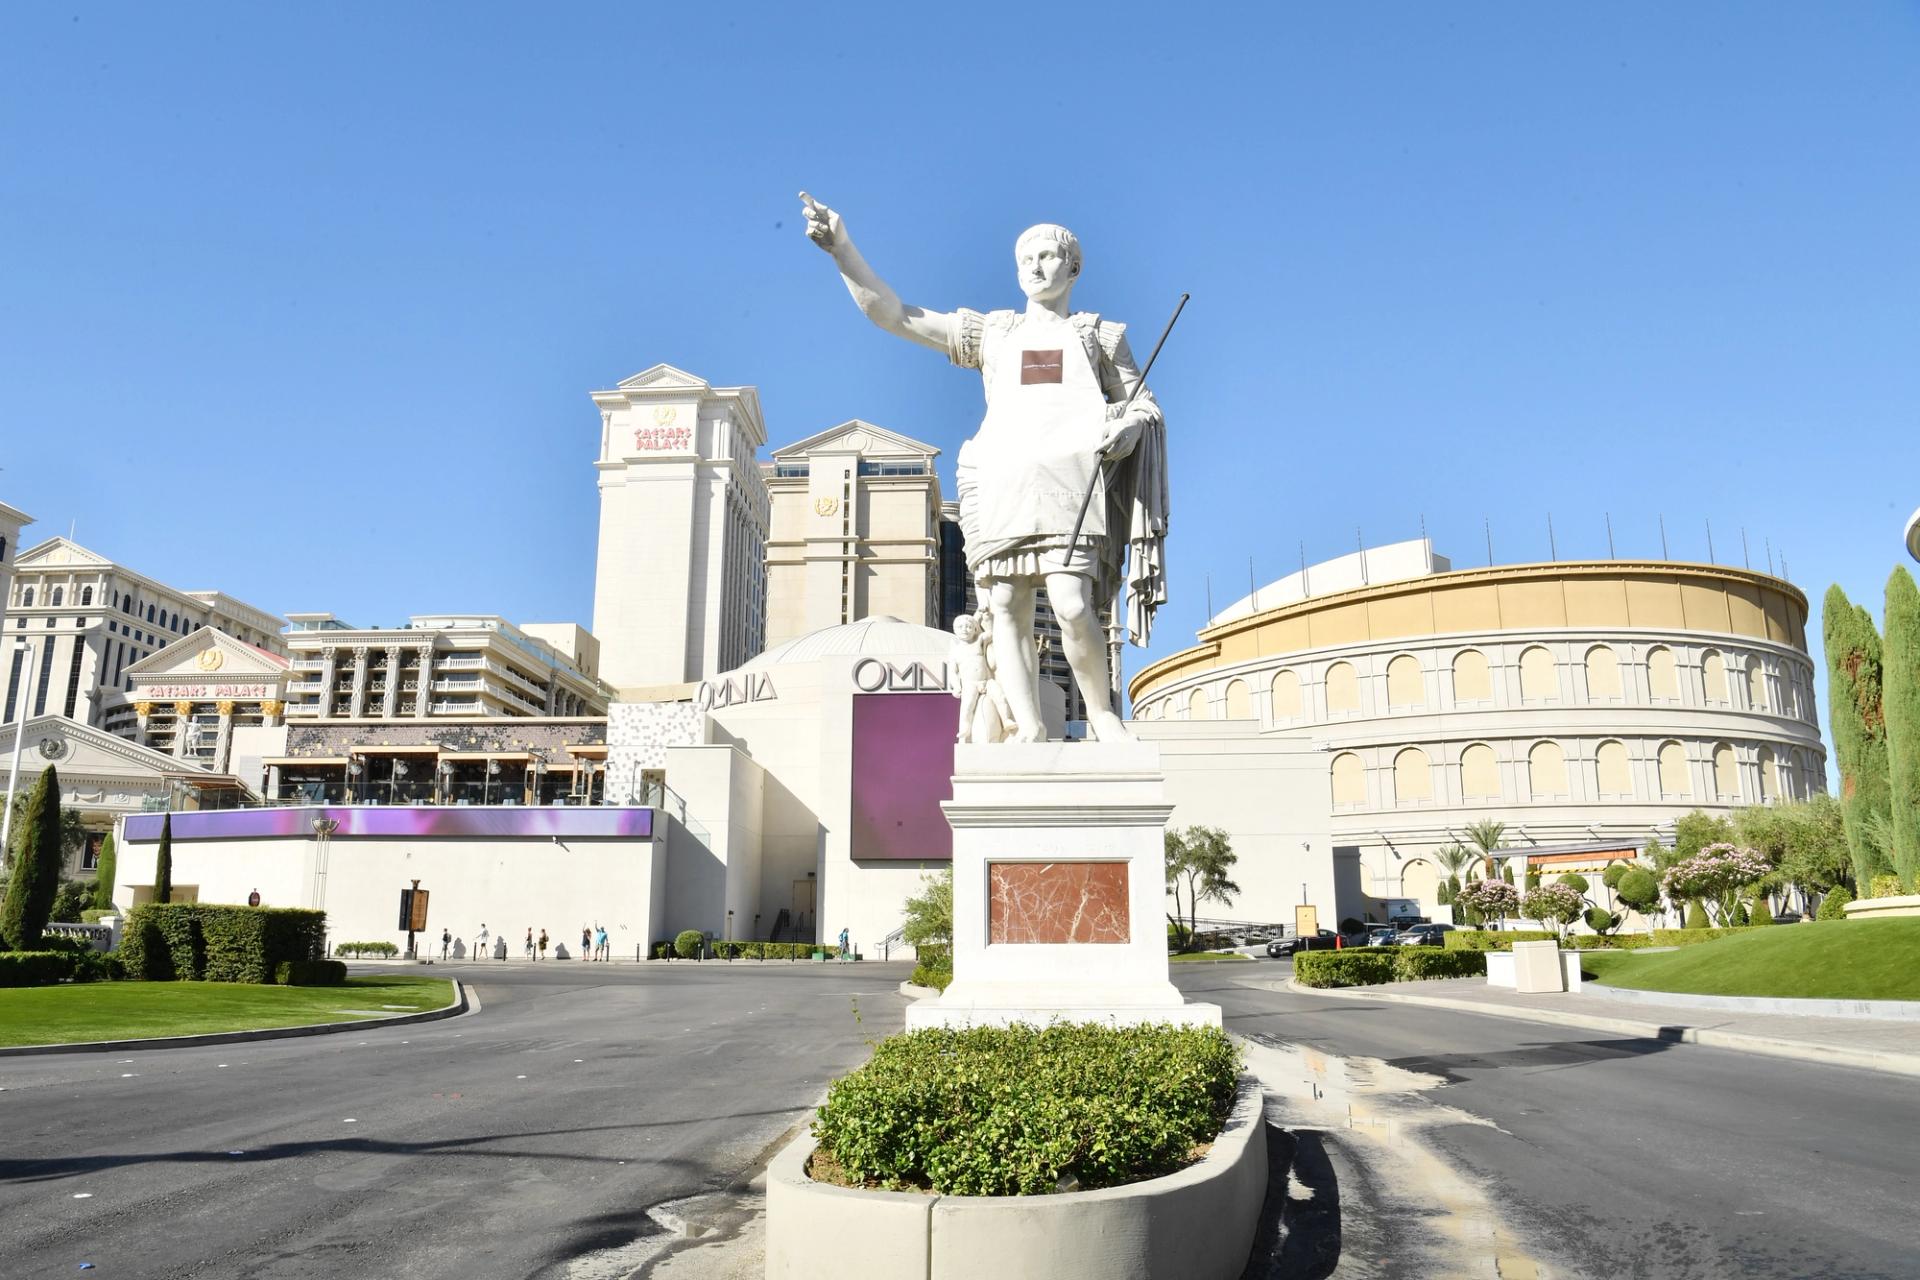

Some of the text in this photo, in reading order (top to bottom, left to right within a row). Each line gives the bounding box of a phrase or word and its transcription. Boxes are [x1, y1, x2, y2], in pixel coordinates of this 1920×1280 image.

[147, 685, 267, 698] CAESARS PALACE
[694, 671, 778, 712] OMNIA
[852, 657, 954, 692] OMN
